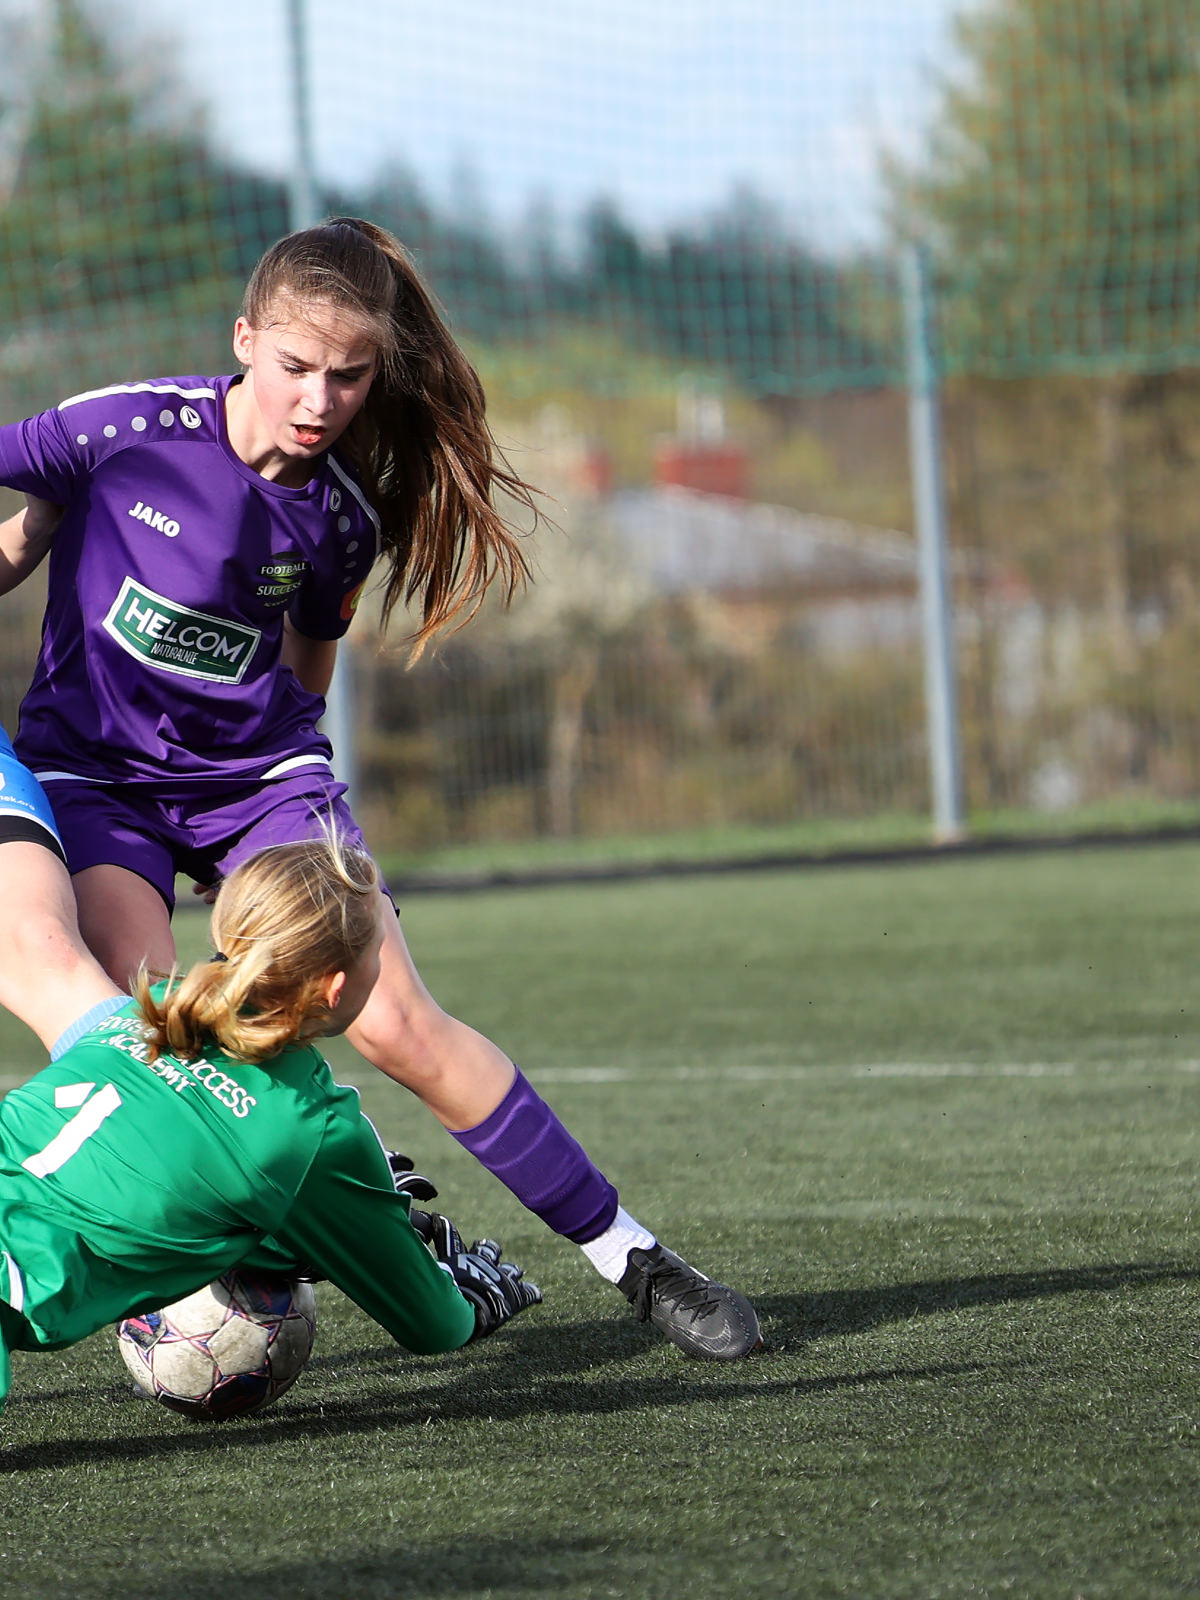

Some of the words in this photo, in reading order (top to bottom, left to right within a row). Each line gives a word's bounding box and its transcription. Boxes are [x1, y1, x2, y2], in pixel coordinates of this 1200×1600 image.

[128, 501, 180, 537] JAKO
[261, 562, 307, 575] FOOTBALL
[124, 597, 247, 664] HELCOM
[151, 642, 200, 665] NATURALNIE
[21, 1082, 123, 1179] 1
